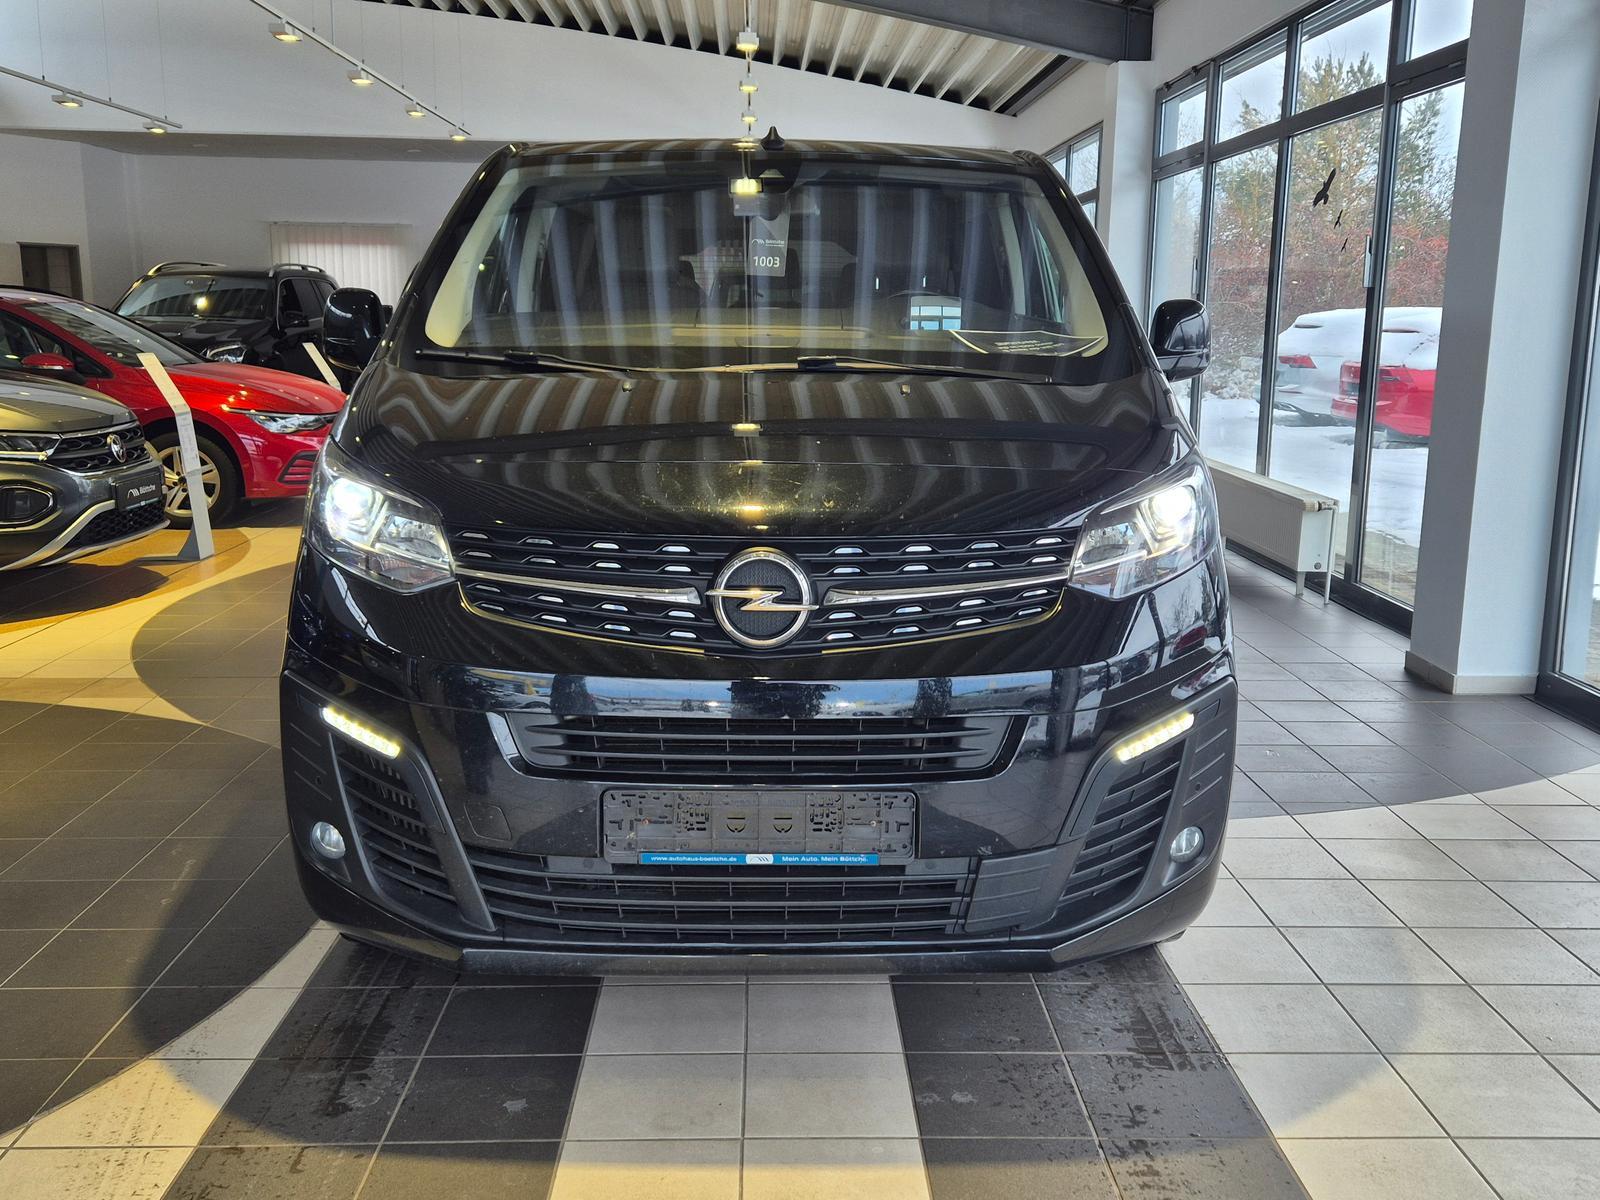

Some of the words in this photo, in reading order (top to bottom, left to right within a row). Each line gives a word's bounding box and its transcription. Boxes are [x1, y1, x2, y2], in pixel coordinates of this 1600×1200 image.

[753, 256, 780, 267] 1003
[781, 855, 800, 863] Mein
[800, 855, 821, 863] Auto.
[821, 855, 838, 863] Mein
